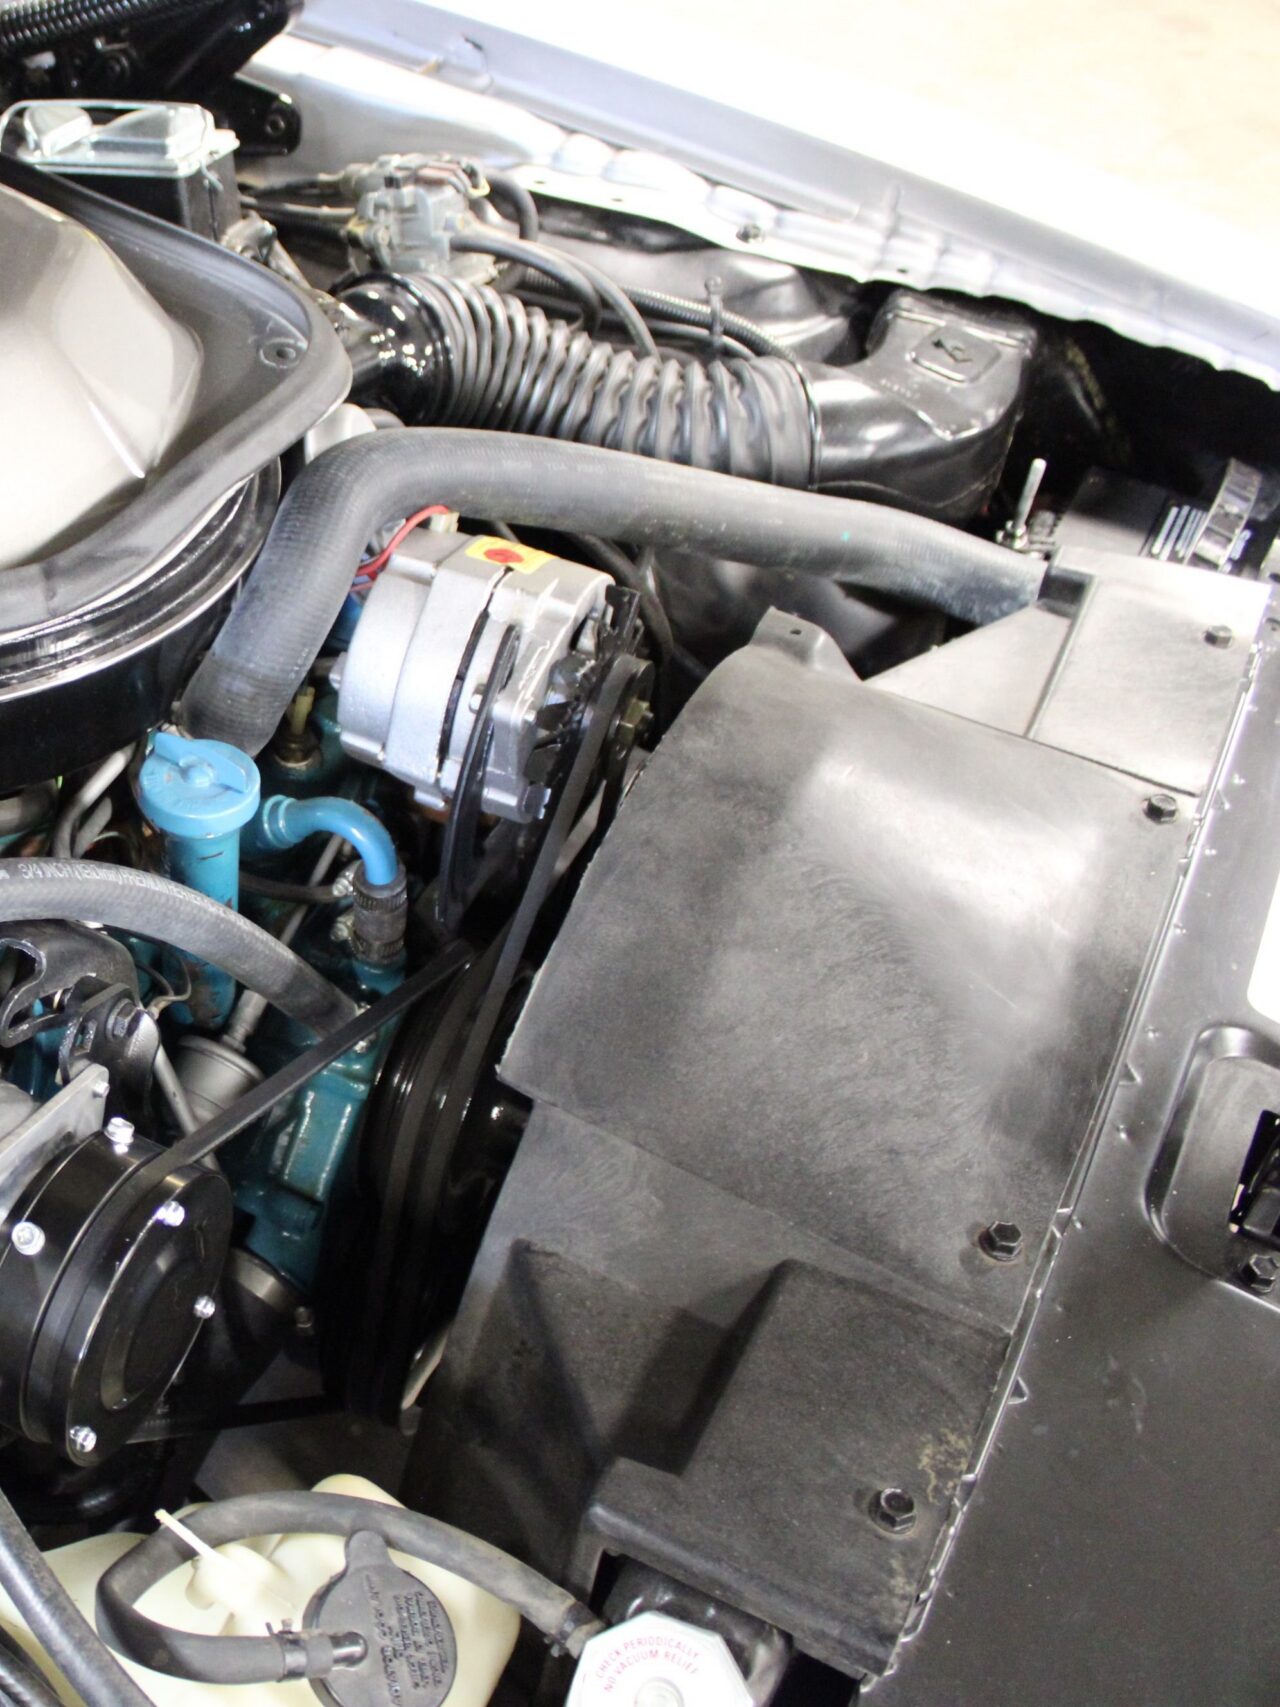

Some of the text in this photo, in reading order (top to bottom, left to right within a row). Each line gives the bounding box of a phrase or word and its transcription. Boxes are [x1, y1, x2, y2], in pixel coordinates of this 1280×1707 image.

[596, 1635, 700, 1679] CHECK PERIODICALLY
[603, 1649, 699, 1693] NO VACUUM RELIEF
